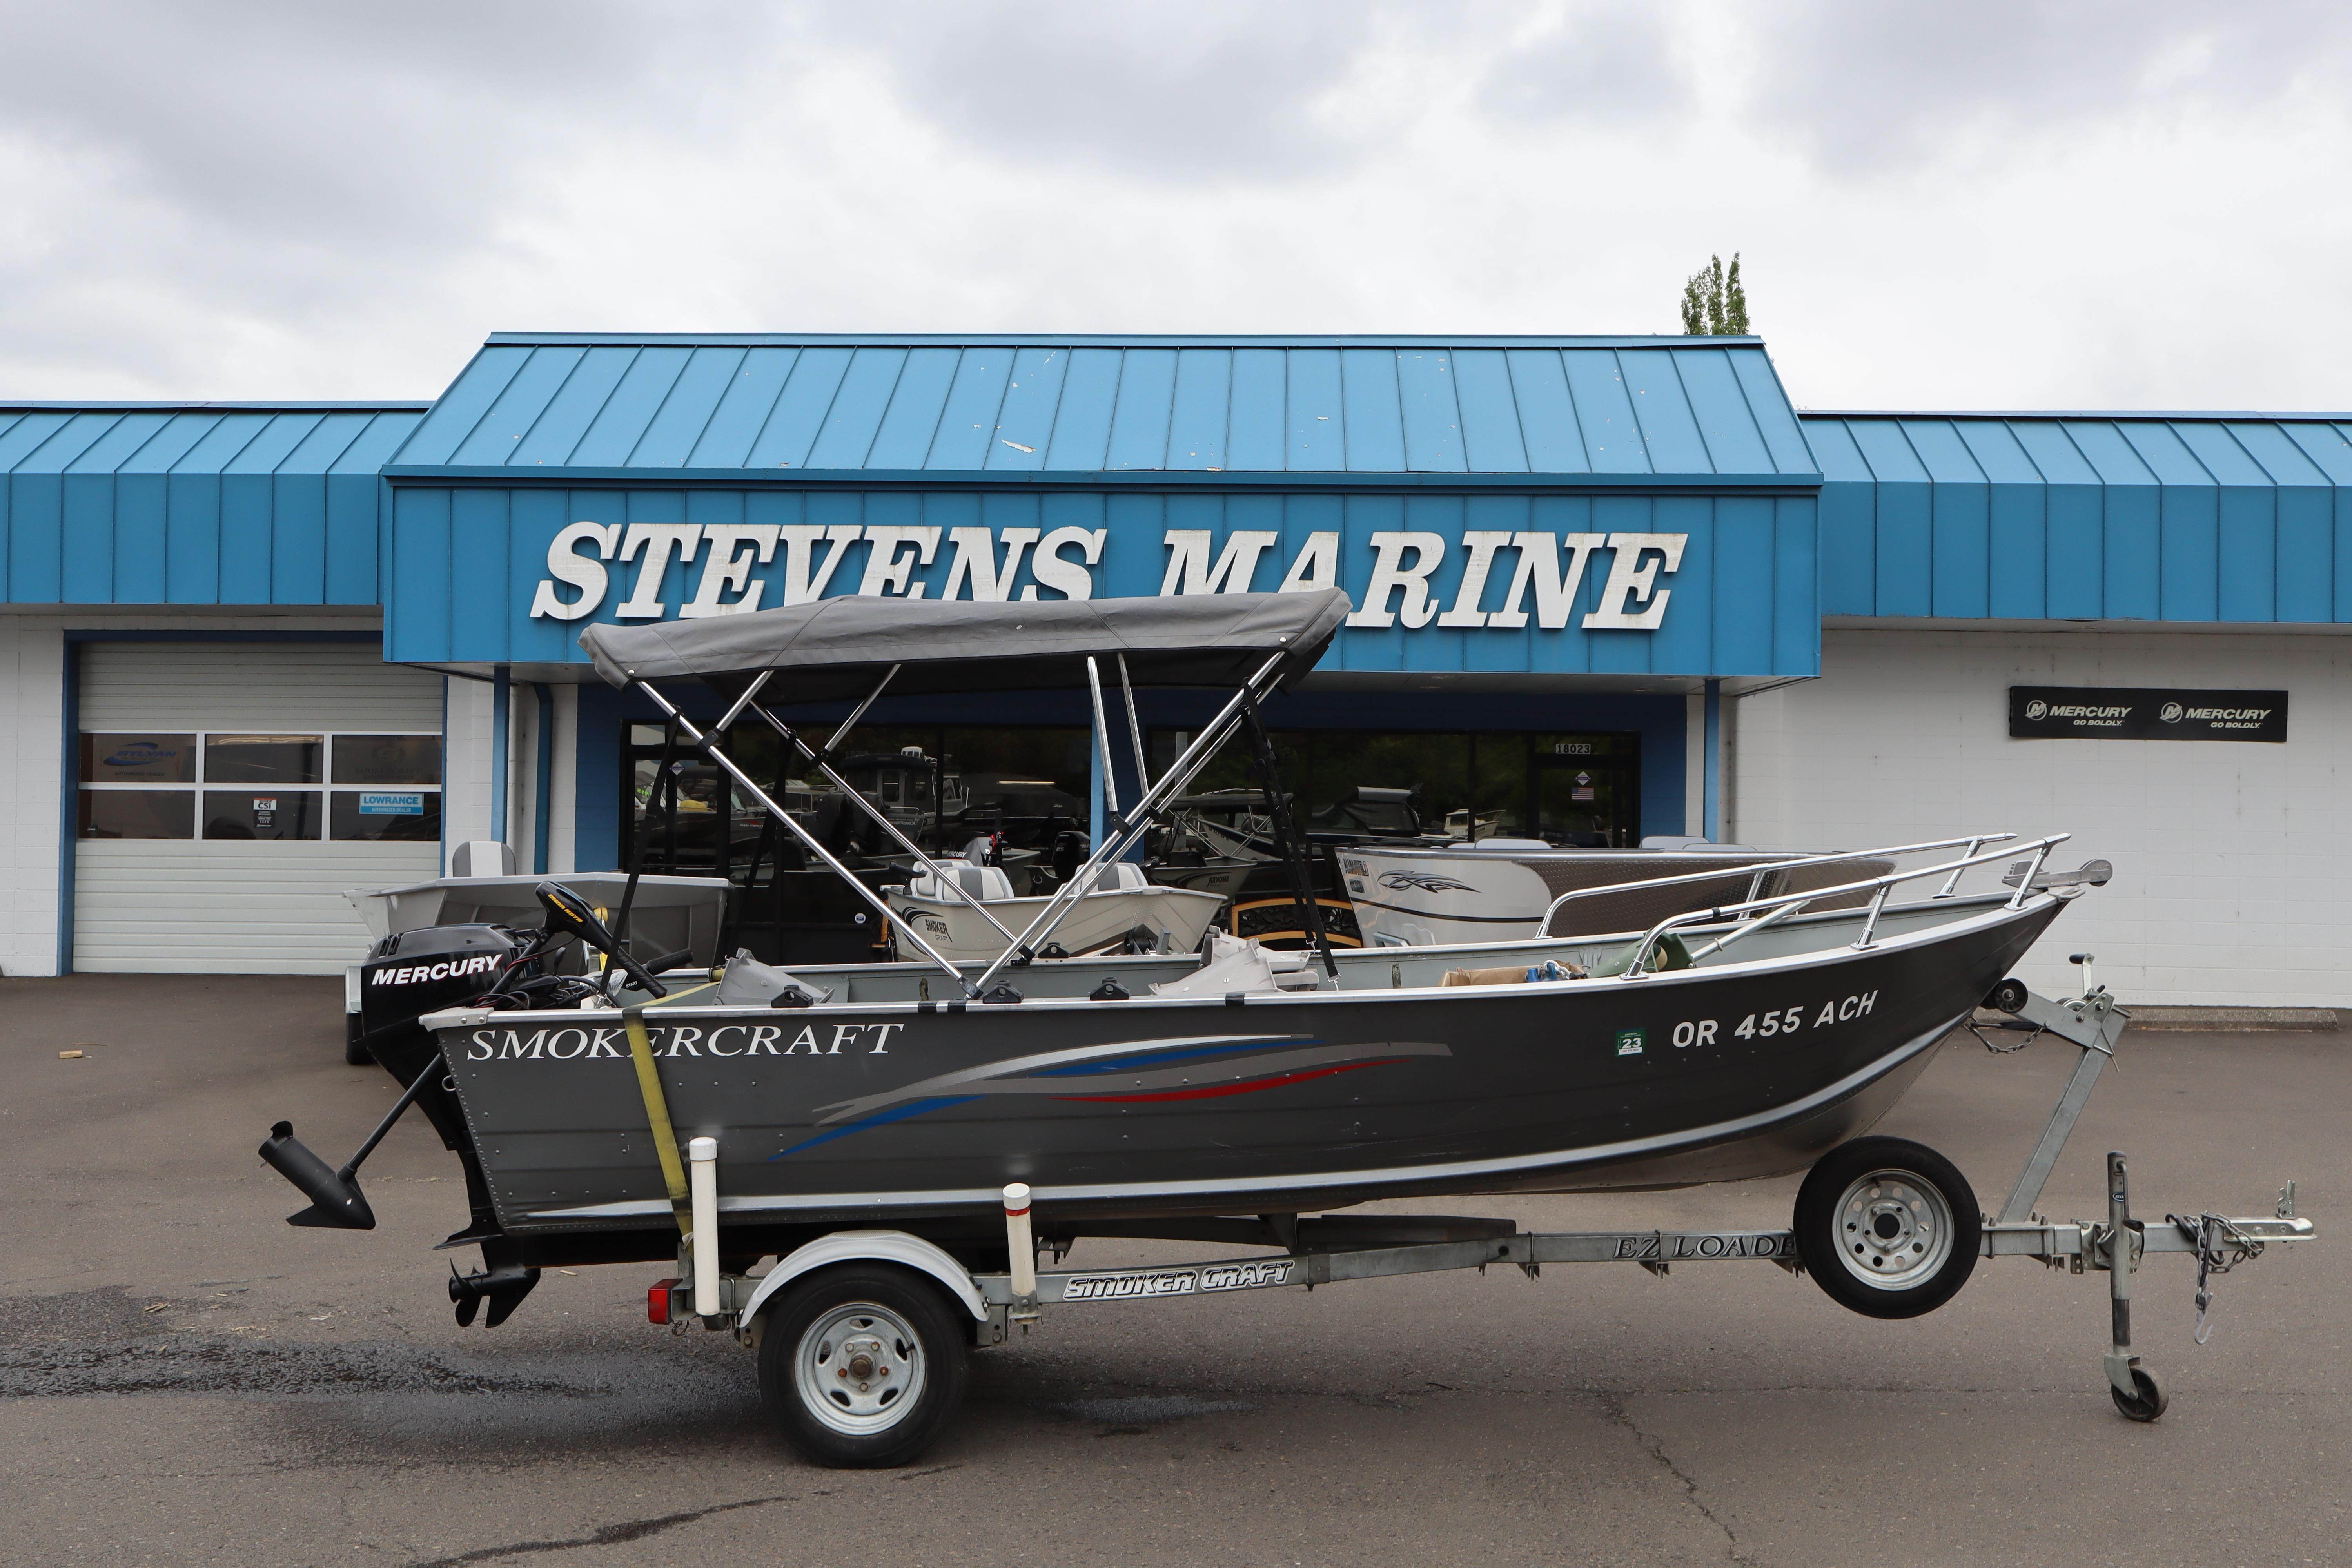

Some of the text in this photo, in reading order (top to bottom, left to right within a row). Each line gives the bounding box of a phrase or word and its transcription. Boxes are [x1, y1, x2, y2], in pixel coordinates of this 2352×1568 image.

[530, 521, 1689, 629] STEVENS MARINE
[2050, 706, 2132, 718] MERCURY
[2185, 708, 2272, 720] MERCURY
[1558, 744, 1590, 753] 18023
[364, 796, 419, 804] LOWRANCE
[564, 909, 583, 922] KOTA
[925, 919, 953, 942] SMOKER
[372, 954, 503, 985] MERCURY
[1673, 990, 1878, 1048] OR 455 ACH
[467, 1024, 904, 1061] SMOKERCRAFT
[1622, 1038, 1641, 1049] 23
[1613, 1236, 1795, 1259] EZ LOADE
[1063, 1261, 1294, 1299] SMOKER CRAFT
